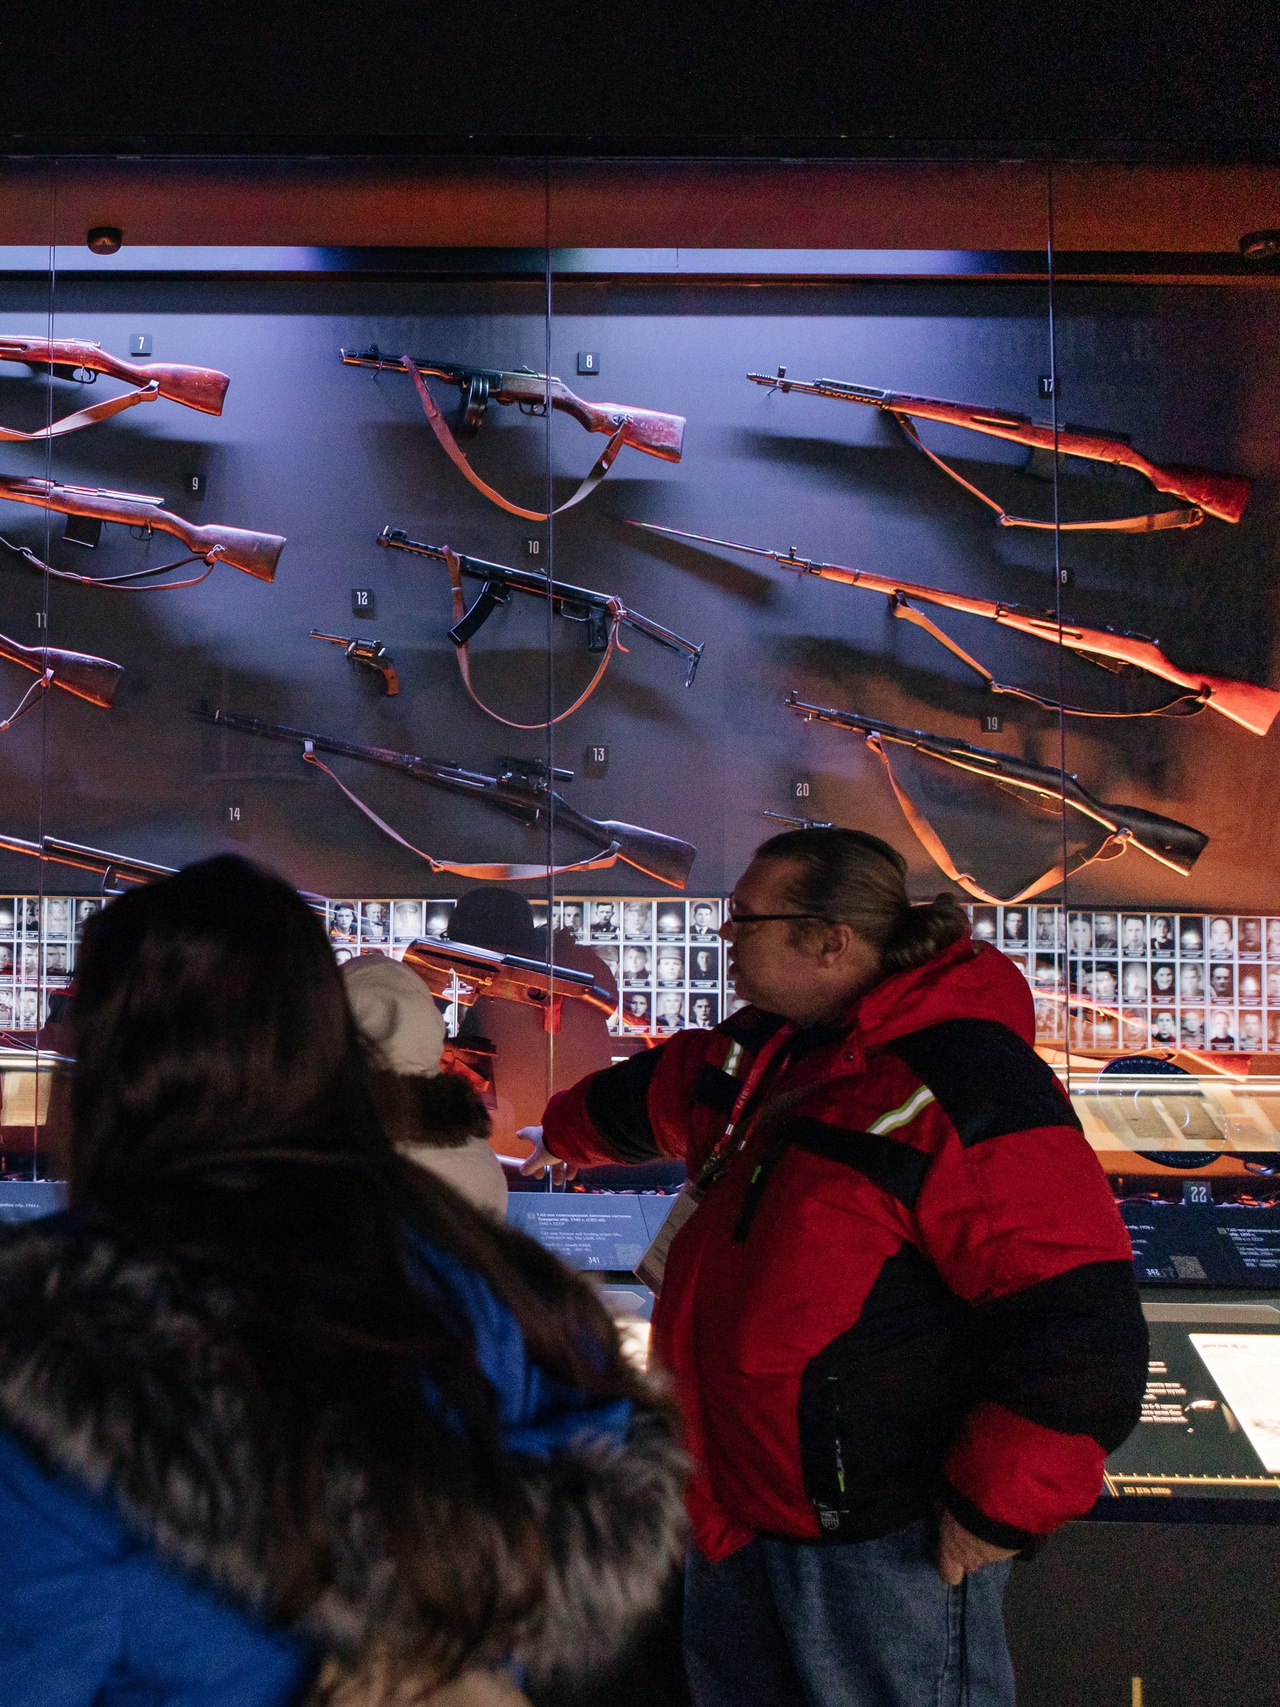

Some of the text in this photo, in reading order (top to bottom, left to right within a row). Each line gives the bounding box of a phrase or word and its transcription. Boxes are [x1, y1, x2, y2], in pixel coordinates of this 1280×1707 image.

[138, 336, 145, 350] 7
[586, 354, 593, 368] 8
[1042, 378, 1053, 392] 17
[192, 477, 199, 490] 9
[528, 540, 540, 554] 10
[356, 591, 368, 605] 12
[36, 612, 47, 628] 11
[987, 716, 998, 731] 19
[593, 747, 605, 761] 13
[796, 782, 809, 796] 20
[229, 807, 240, 821] 14
[1190, 1186, 1207, 1203] 22
